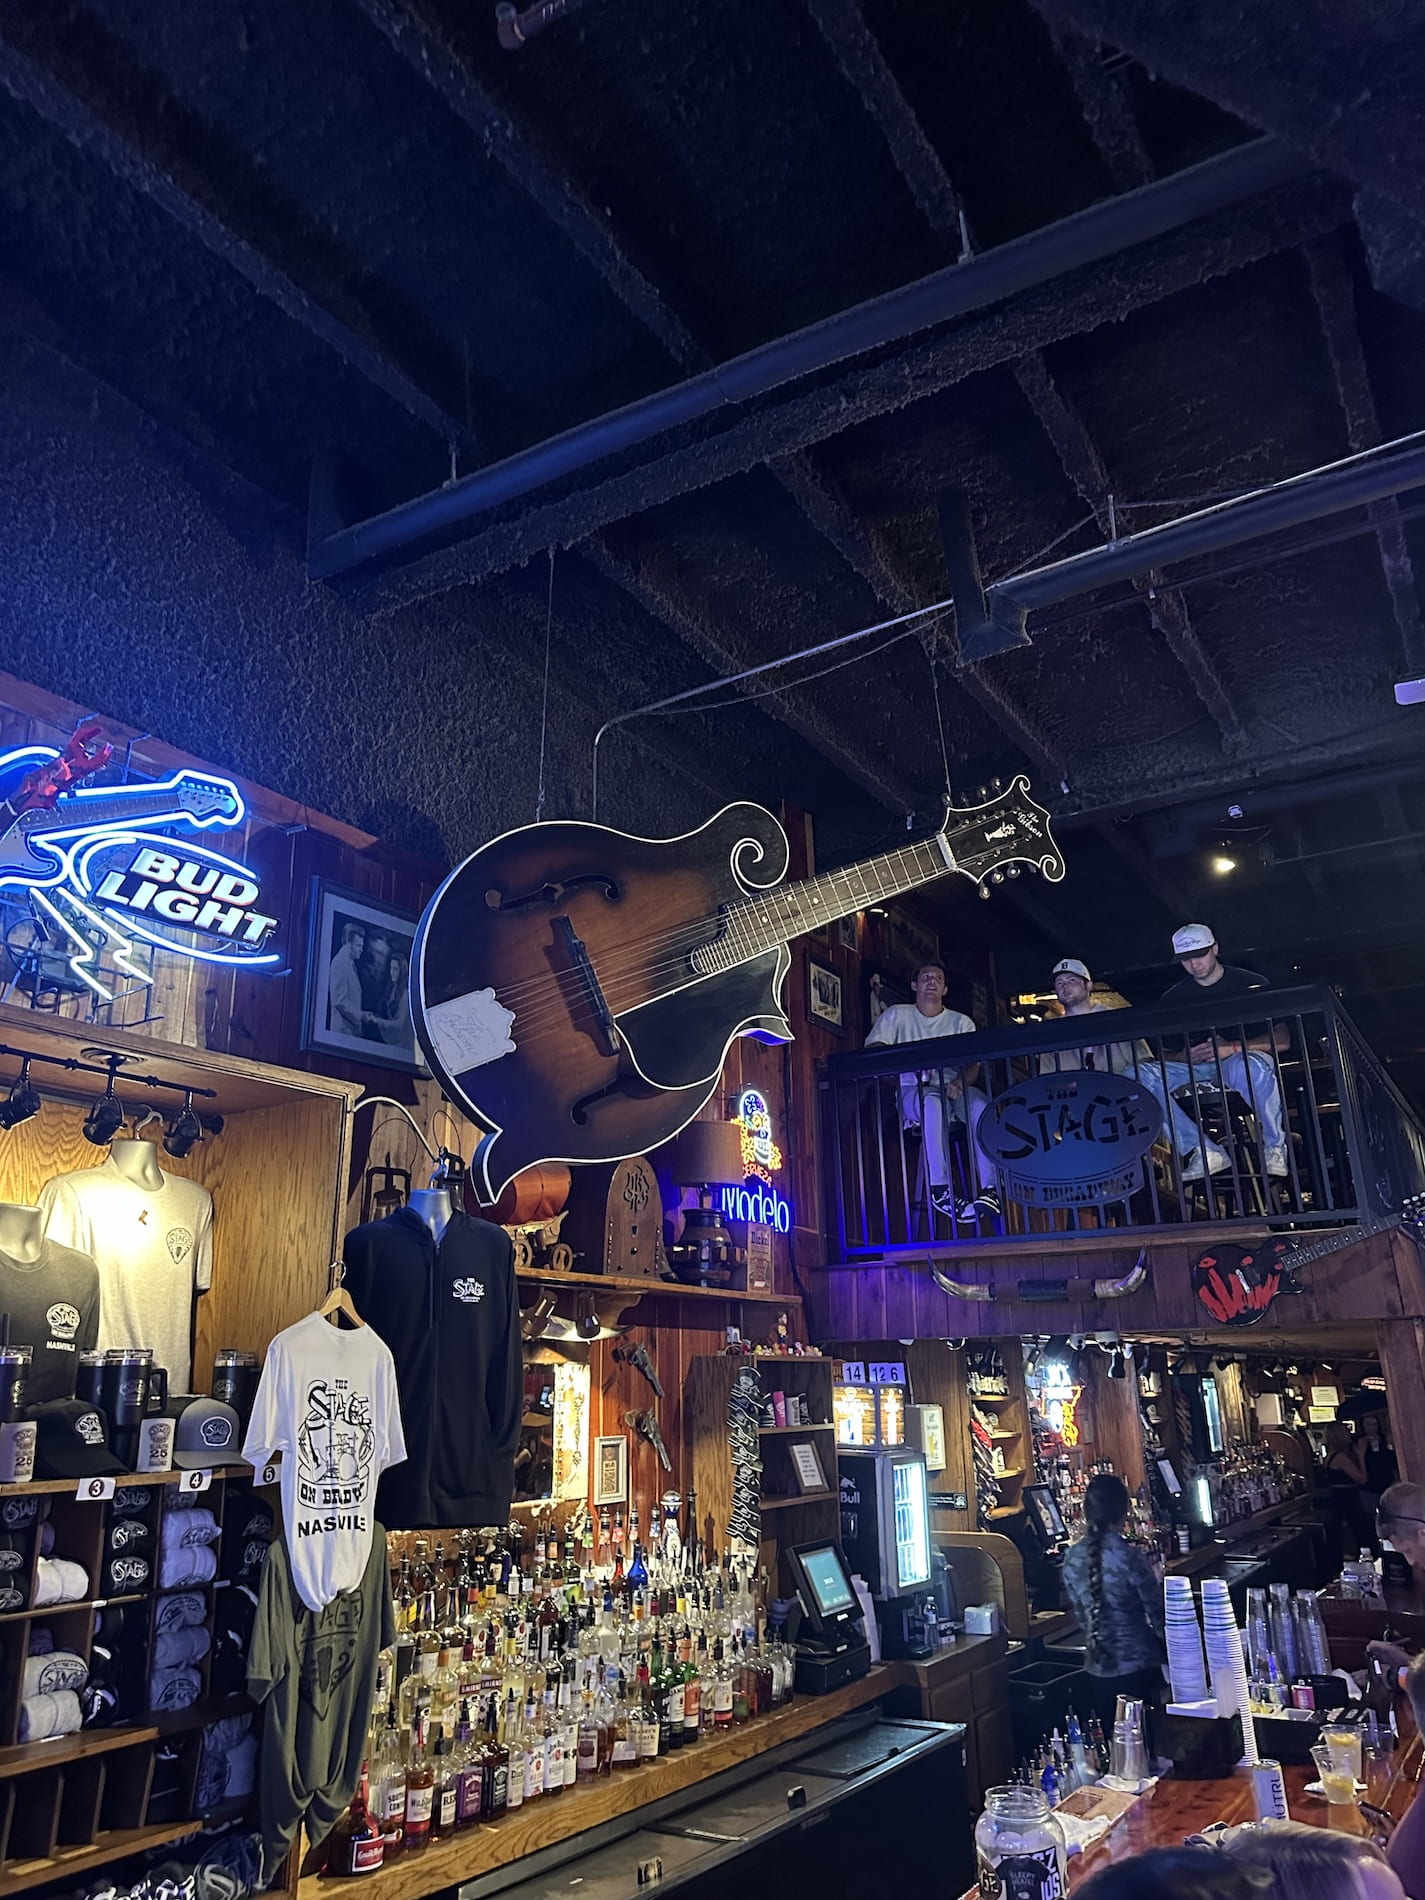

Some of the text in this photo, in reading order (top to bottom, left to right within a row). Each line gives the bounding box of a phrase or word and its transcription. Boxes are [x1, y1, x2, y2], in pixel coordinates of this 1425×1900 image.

[1017, 812, 1042, 838] Gibson
[1026, 812, 1040, 823] The
[129, 847, 260, 907] BUD
[96, 872, 279, 944] LIGHT
[995, 1093, 1150, 1160] STAGE
[721, 1185, 791, 1234] Modelo
[452, 1279, 485, 1297] STAGE
[845, 1365, 862, 1382] 14
[871, 1367, 887, 1382] 12
[890, 1367, 899, 1382] 6
[335, 1379, 348, 1390] THE
[307, 1379, 372, 1427] STAGE
[149, 1449, 169, 1459] 25
[191, 1473, 201, 1488] 4
[264, 1466, 274, 1483] 5
[92, 1482, 102, 1497] 3
[300, 1483, 316, 1504] ON
[840, 1491, 861, 1504] Bull
[112, 1560, 149, 1582] STAGE
[1270, 1772, 1287, 1820] ÜTRL
